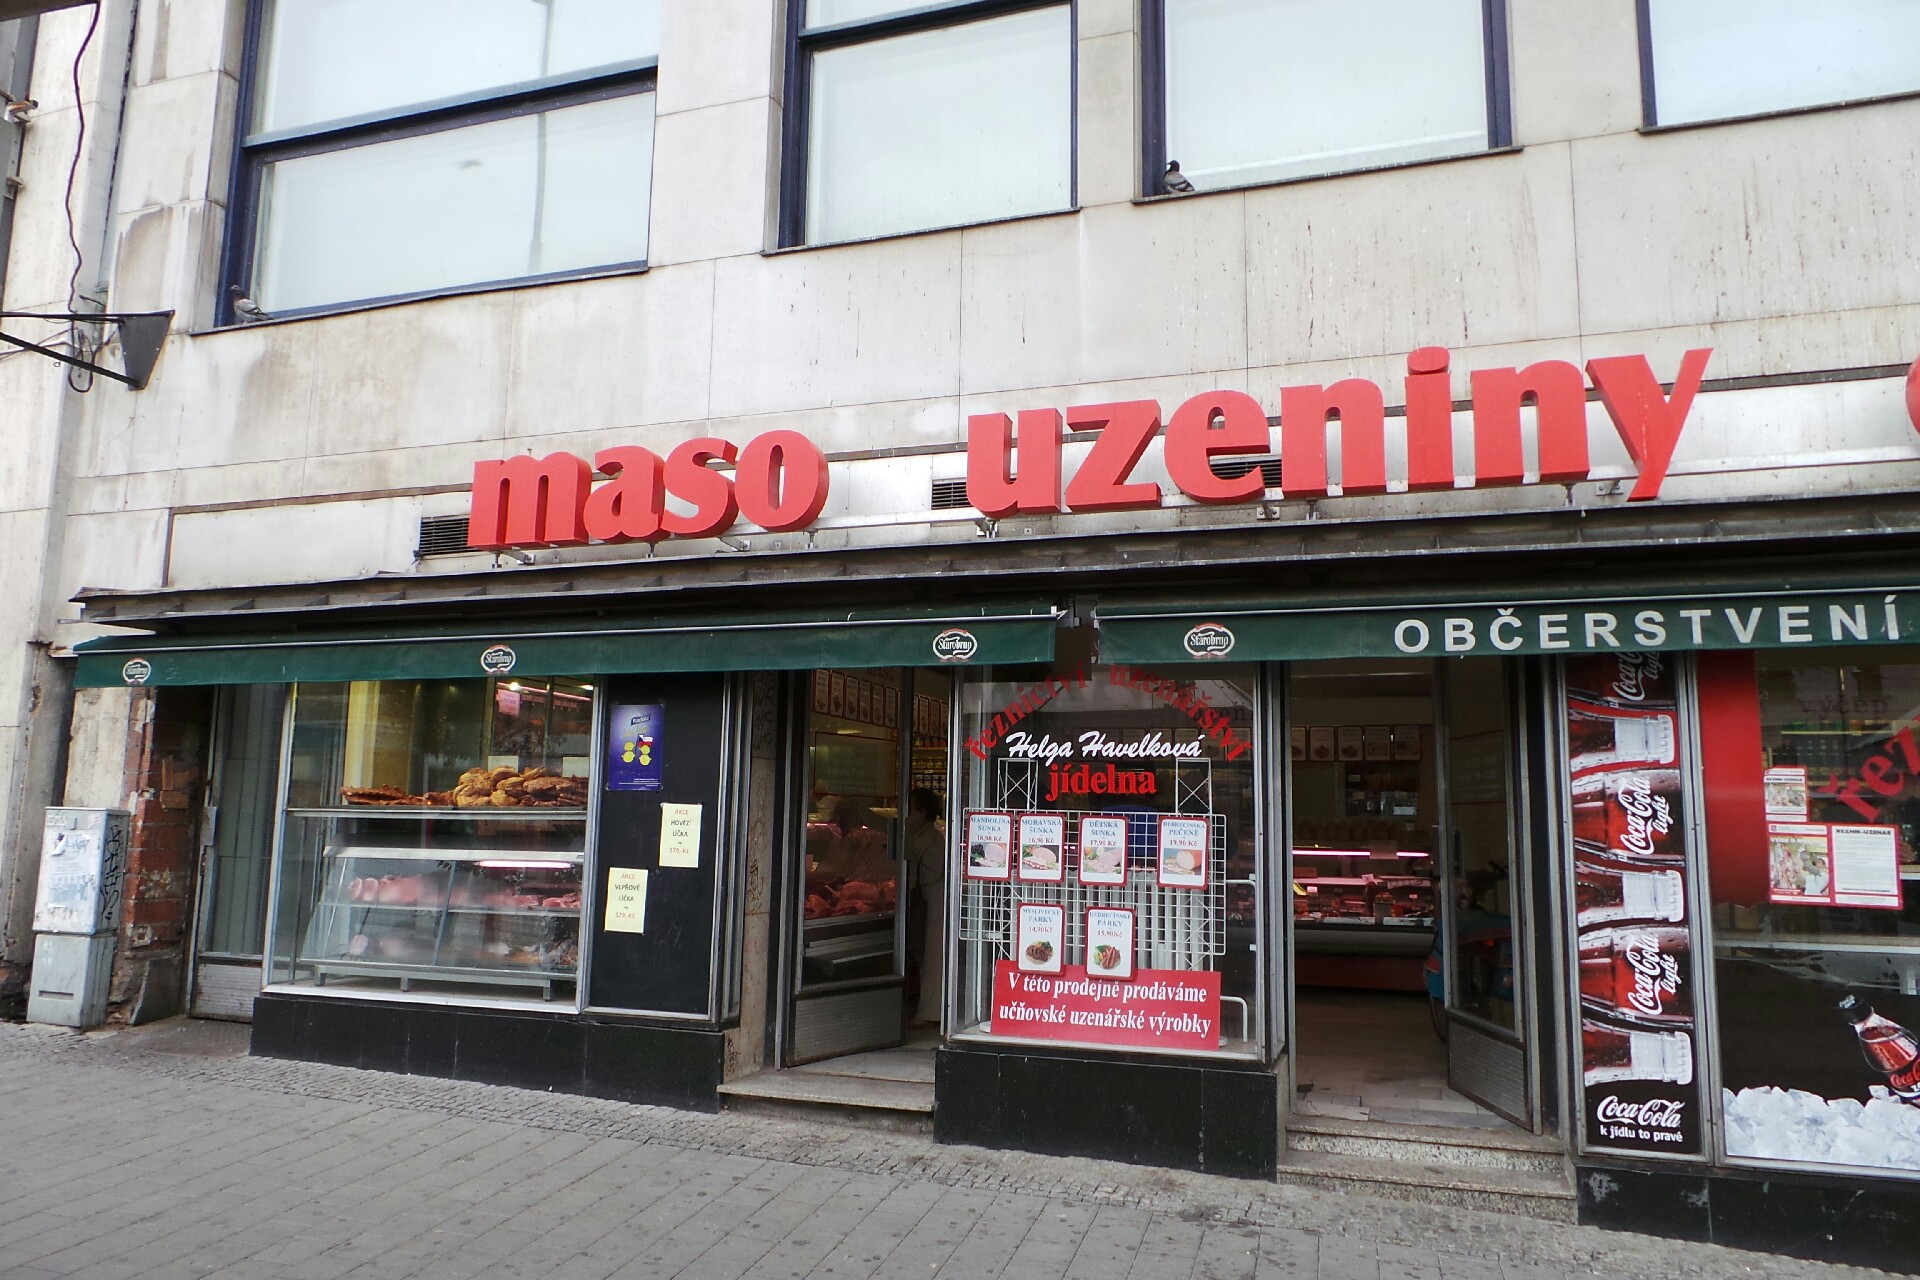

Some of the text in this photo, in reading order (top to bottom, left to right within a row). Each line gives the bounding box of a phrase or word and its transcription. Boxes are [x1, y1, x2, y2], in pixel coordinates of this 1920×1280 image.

[468, 346, 1714, 550] maso uzeniny
[1394, 594, 1898, 653] OBČERSTVENÍ
[1005, 730, 1207, 767] Helga Havelková
[1045, 763, 1158, 802] jídelna
[1818, 714, 1920, 822] řez
[977, 823, 1002, 832] ŠUNKA
[1029, 825, 1054, 834] ŠUNKA
[1090, 828, 1116, 837] ŠUNKA
[1618, 776, 1655, 855] Coca-Cola
[1652, 795, 1674, 836] light
[1008, 972, 1207, 1002] V této prodejně prodáváme
[1626, 934, 1664, 1015] Coca-Cola
[1660, 954, 1682, 995] light
[999, 1001, 1212, 1038] učňovské uzenářské výrobky
[1597, 1095, 1686, 1128] Coca-Cola
[1600, 1124, 1684, 1143] k jídlu to pravé
